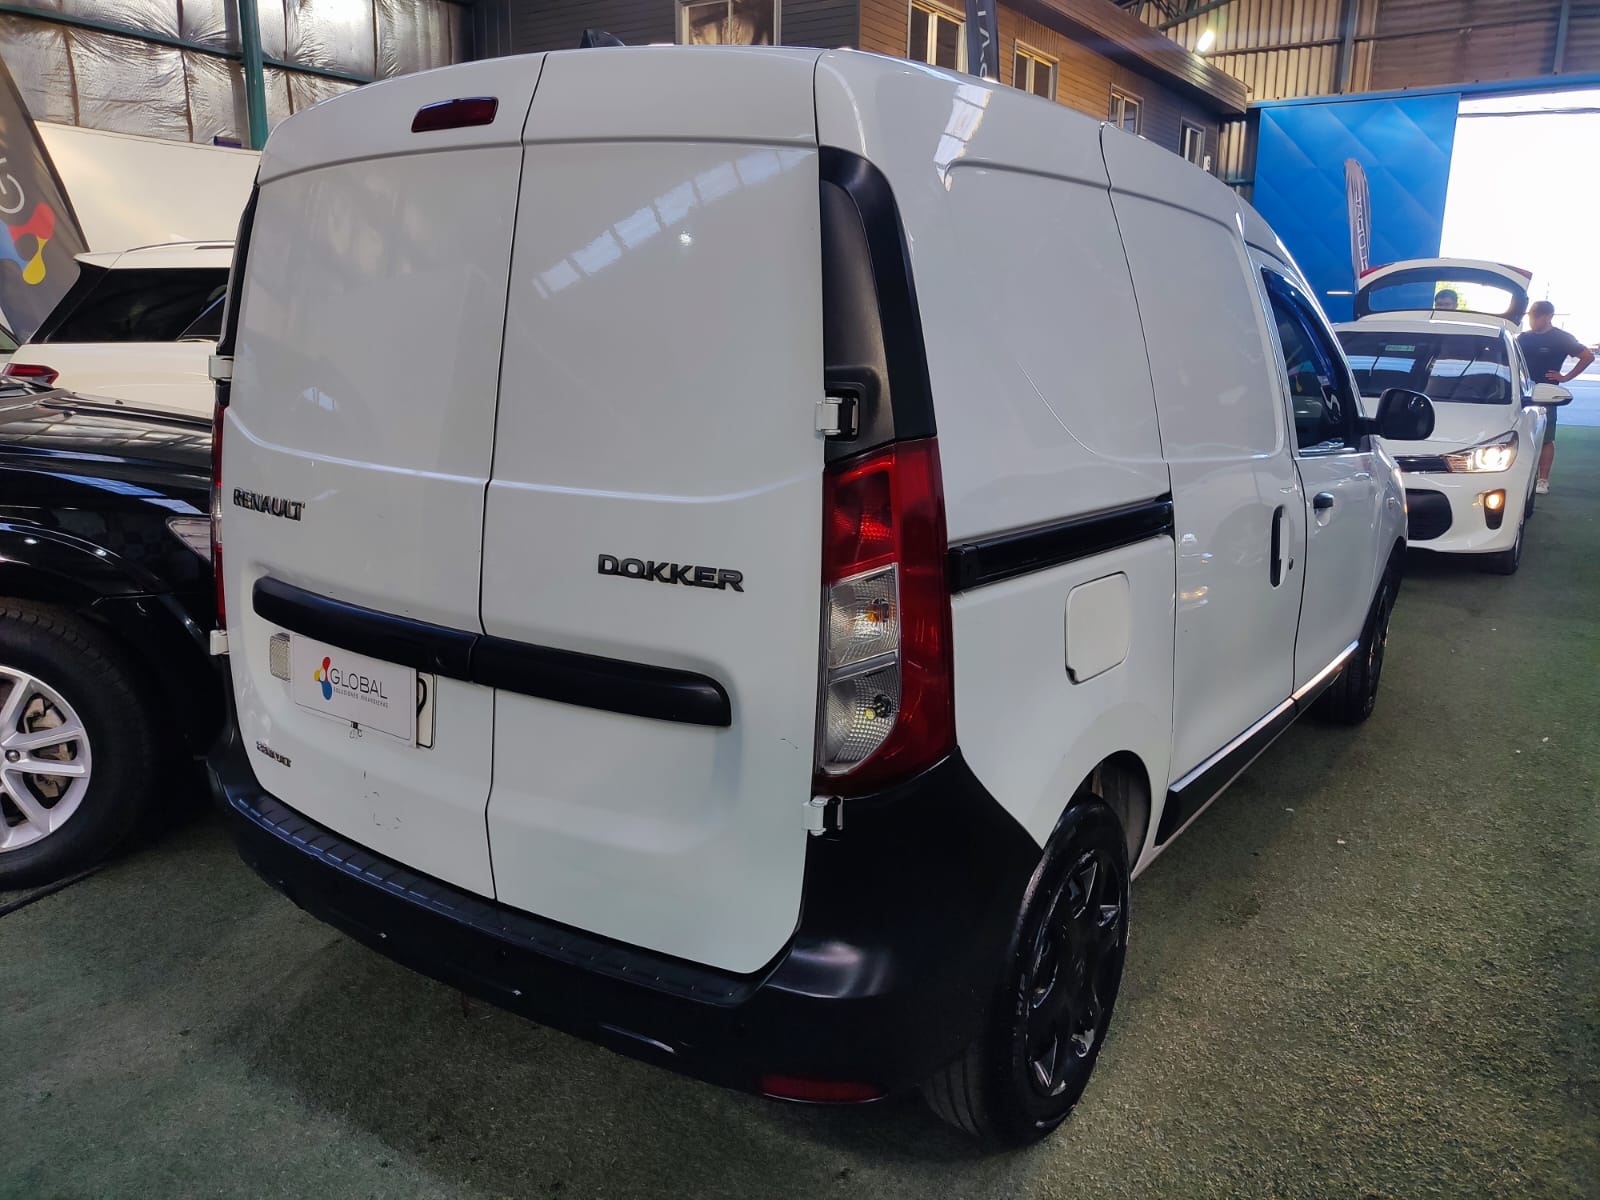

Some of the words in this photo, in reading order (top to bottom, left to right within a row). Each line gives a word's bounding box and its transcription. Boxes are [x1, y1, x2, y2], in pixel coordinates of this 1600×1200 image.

[233, 488, 305, 521] RENAULT
[598, 554, 744, 592] DOKKER
[330, 668, 388, 700] GLOBAL
